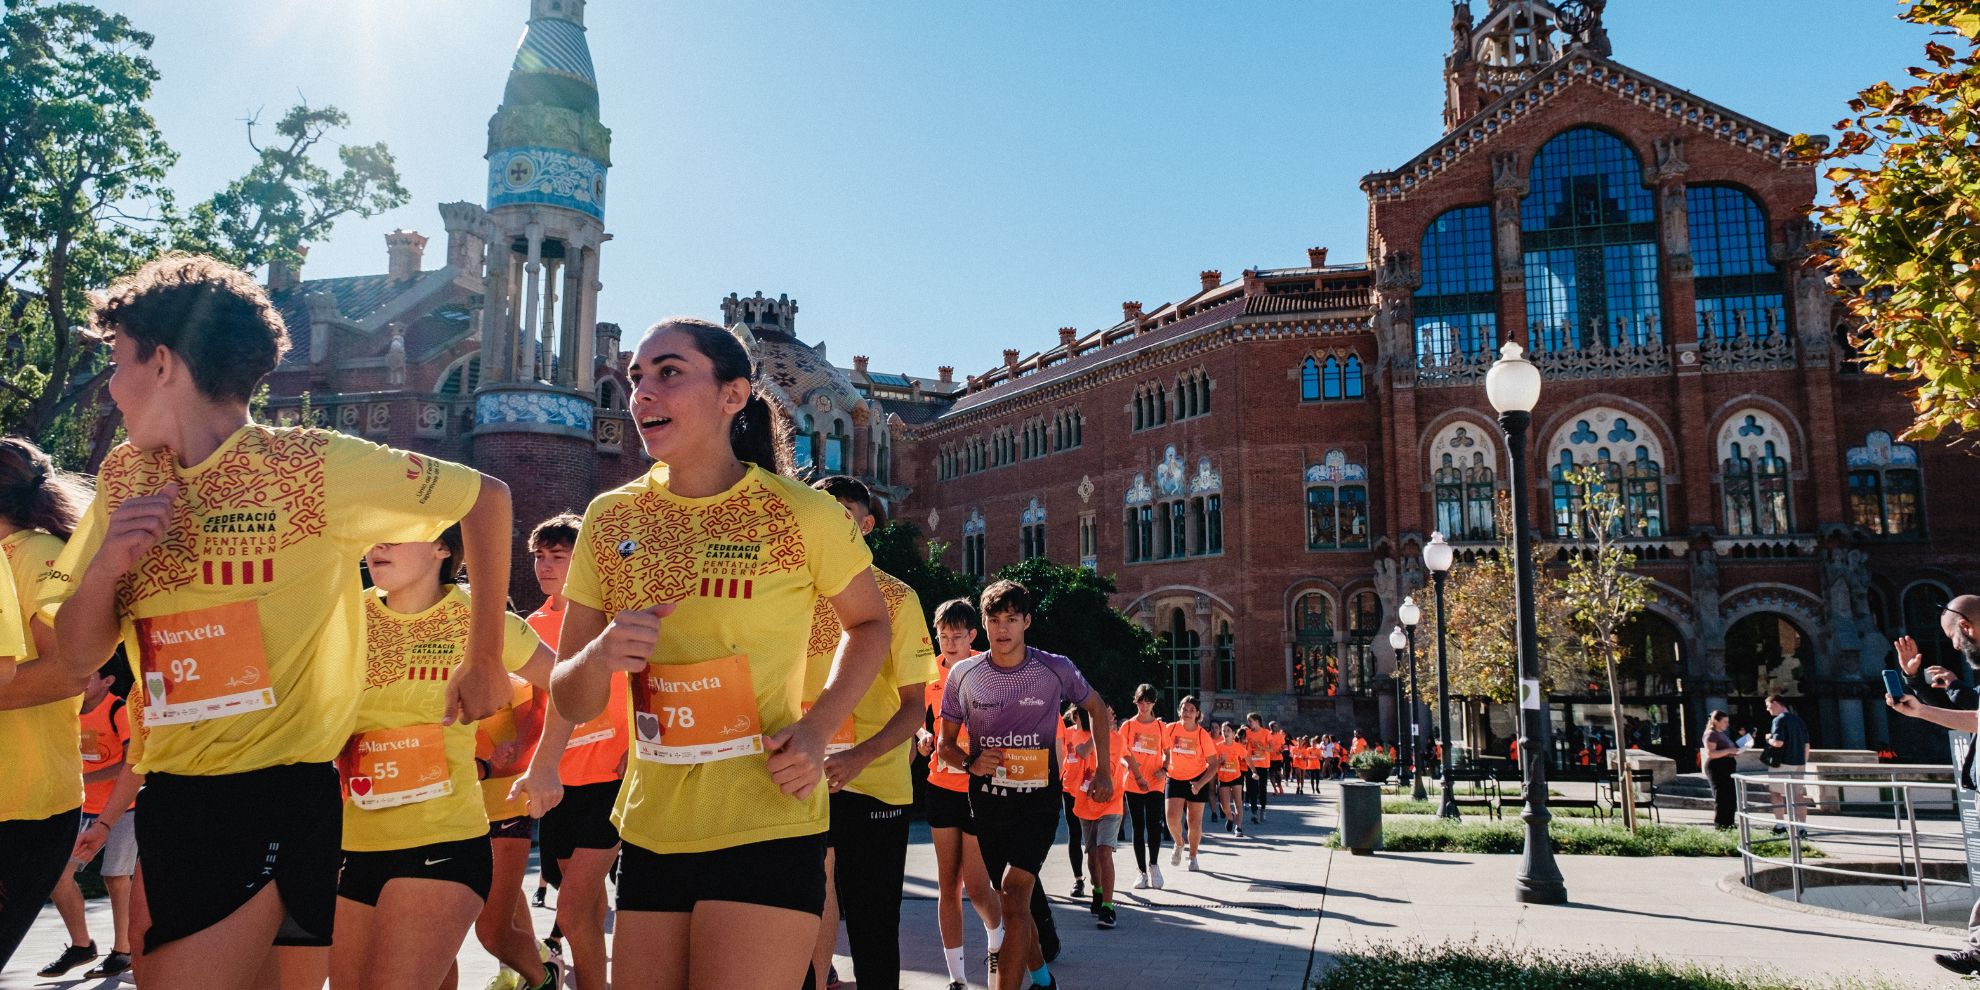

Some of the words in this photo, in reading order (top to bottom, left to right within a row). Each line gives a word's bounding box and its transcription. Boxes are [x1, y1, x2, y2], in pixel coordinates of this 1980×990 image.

[206, 510, 277, 524] FEDERACIÓ
[203, 523, 277, 533] CATALANA
[205, 533, 276, 546] PENTATLÓ
[203, 546, 276, 556] MODERN
[707, 543, 761, 552] FEDERACIÓ
[706, 551, 758, 560] CATALANA
[703, 560, 757, 569] PENTATLÓ
[702, 568, 756, 576] MODERN
[151, 624, 225, 645] #Marxeta
[170, 657, 200, 683] 92
[648, 676, 721, 693] #Marxeta
[662, 706, 695, 728] 78
[358, 737, 420, 753] #Marxeta
[373, 761, 399, 780] 55
[1011, 765, 1024, 774] 93
